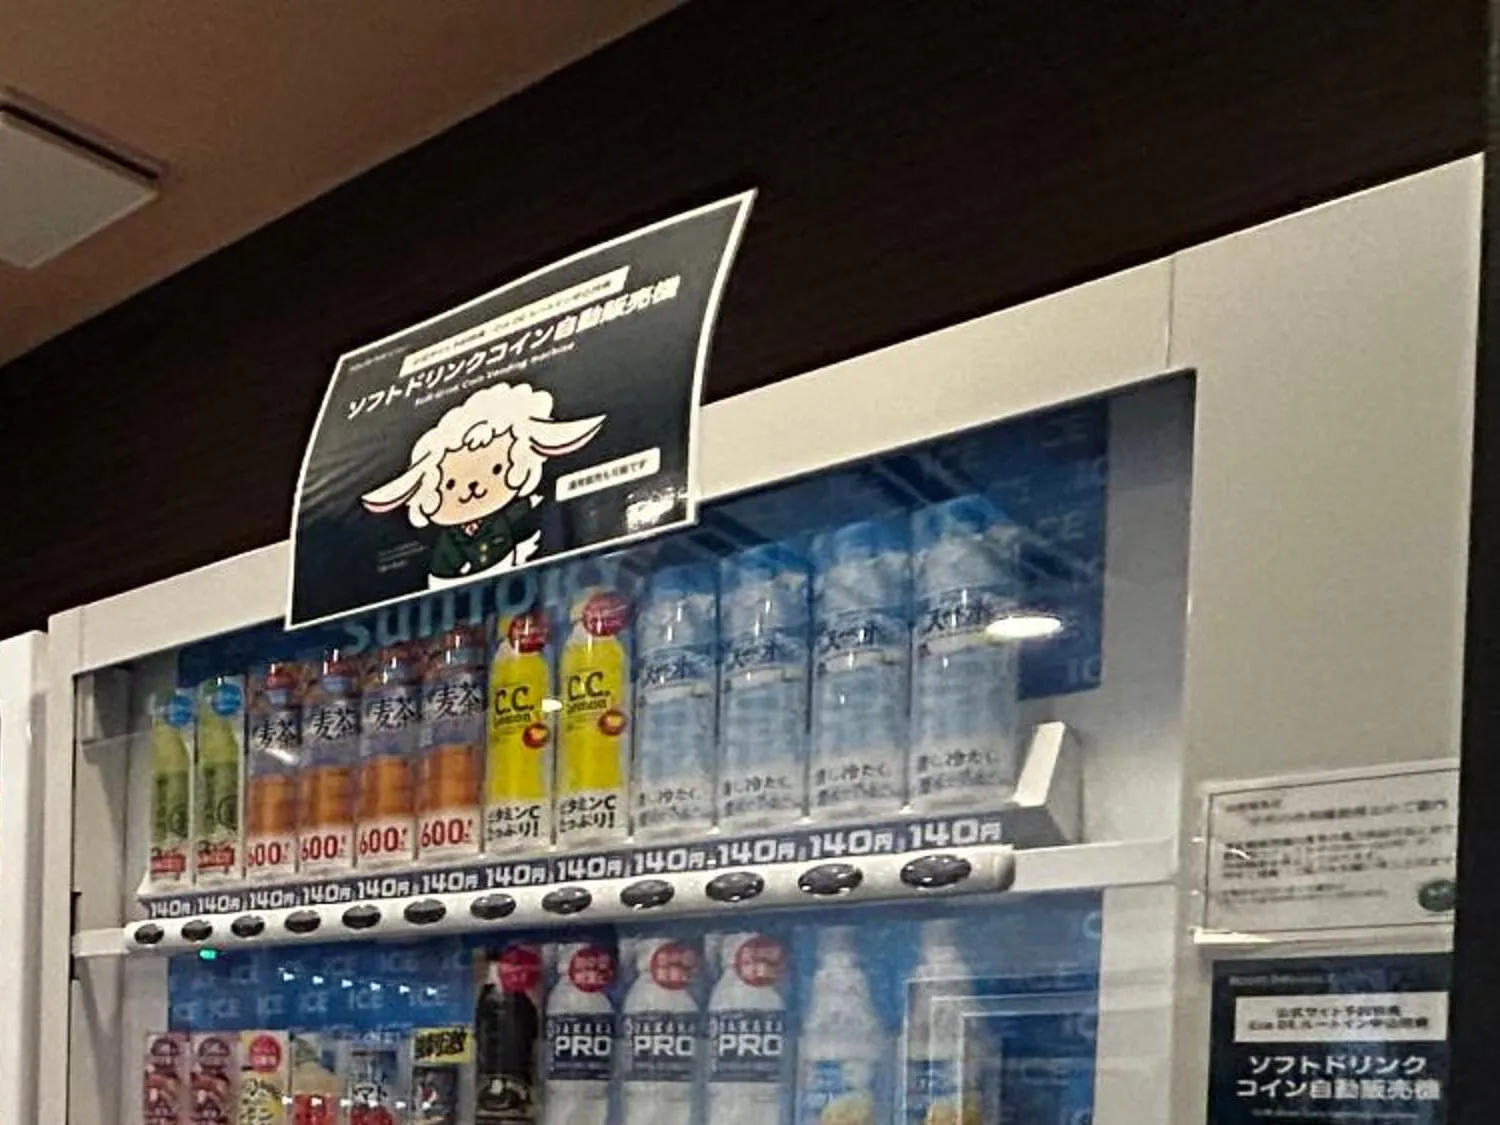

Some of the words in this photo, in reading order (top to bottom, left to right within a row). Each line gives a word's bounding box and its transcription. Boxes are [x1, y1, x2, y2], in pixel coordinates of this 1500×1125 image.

[555, 1034, 612, 1057] PRO
[633, 1035, 696, 1058] PRO
[718, 1033, 783, 1057] PRO
[1248, 1055, 1427, 1075] ソフトドリンク
[1236, 1078, 1441, 1101] コイン自動販売機
